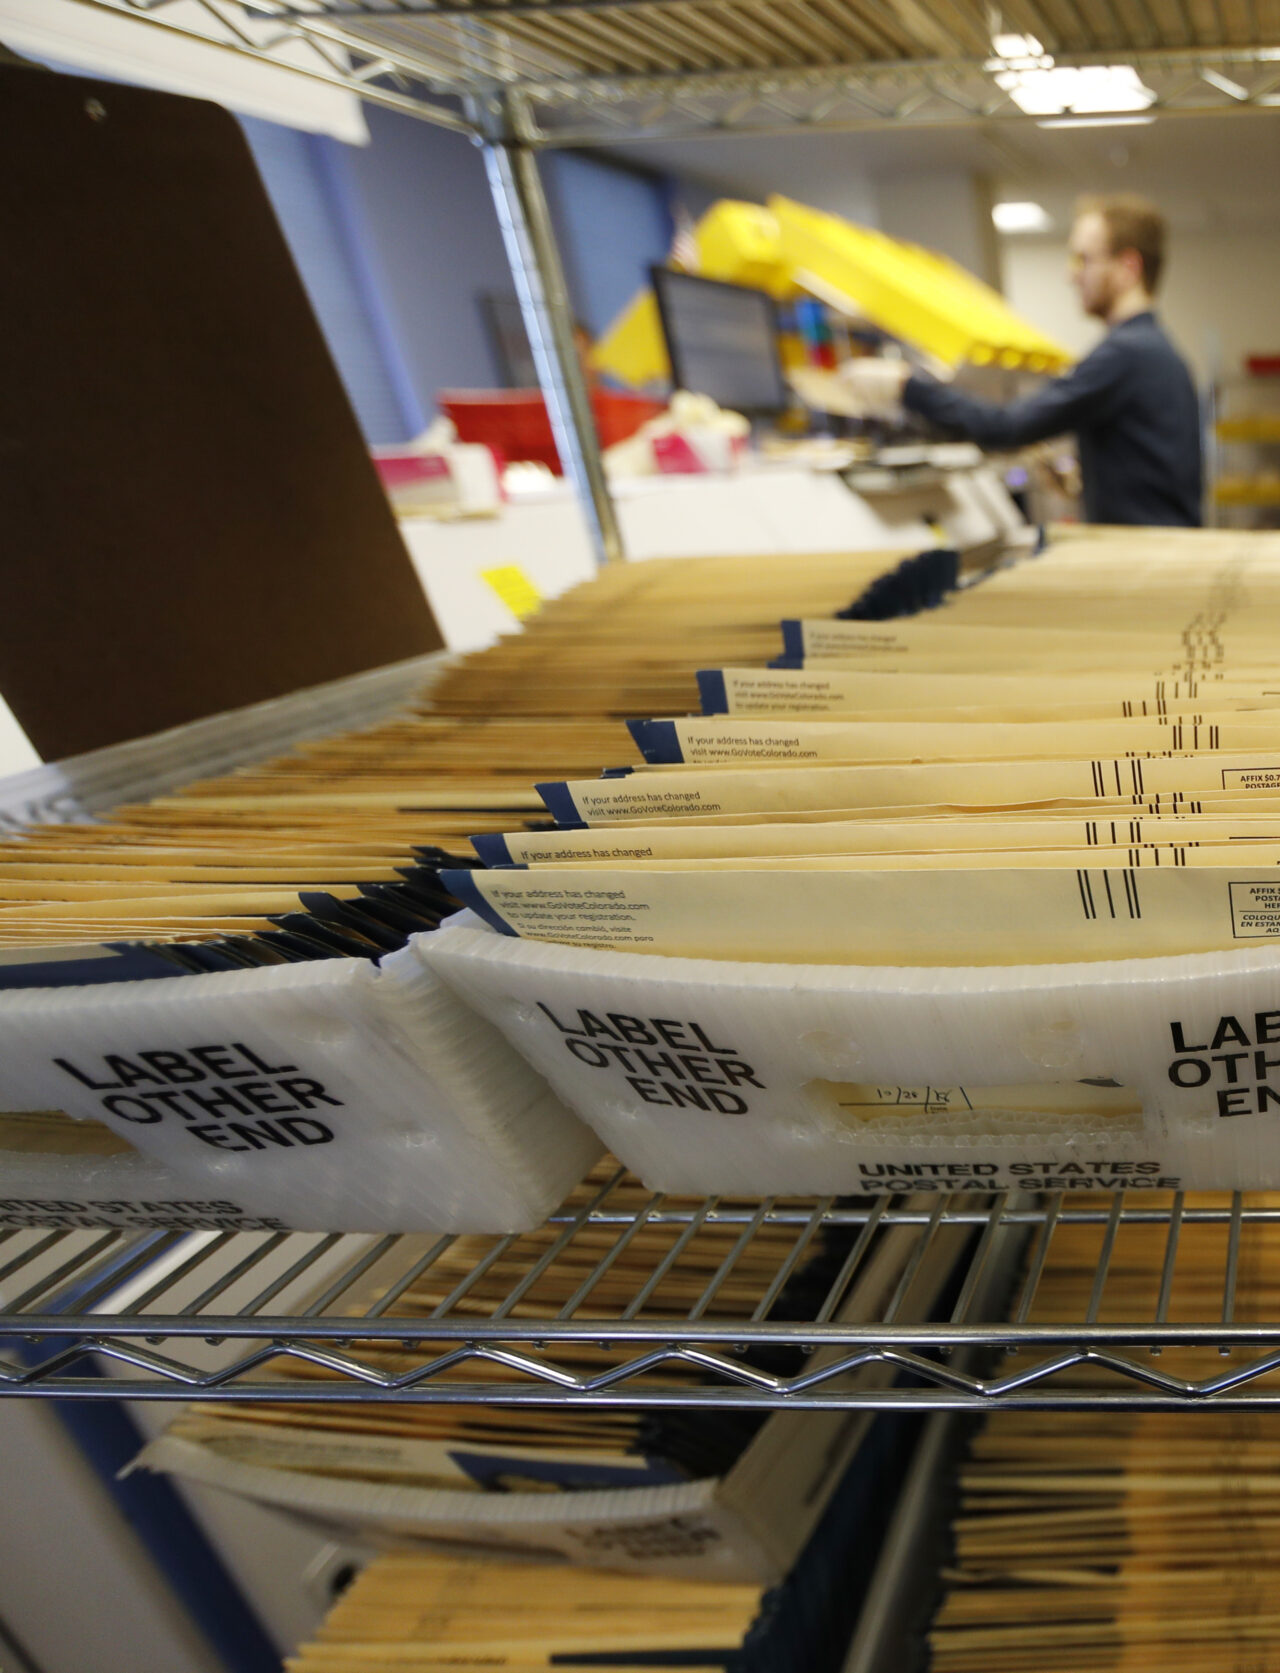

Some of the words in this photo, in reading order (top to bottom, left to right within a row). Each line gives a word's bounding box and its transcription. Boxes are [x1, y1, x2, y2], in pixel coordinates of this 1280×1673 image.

[687, 736, 694, 744] If
[695, 738, 714, 747] your
[716, 736, 748, 745] address
[749, 737, 763, 745] has
[764, 737, 800, 747] changed
[690, 747, 708, 756] visit
[709, 748, 818, 758] www.GoVoteColorado.com
[582, 796, 590, 805] If
[590, 796, 610, 806] your
[613, 794, 646, 804] address
[647, 793, 663, 801] has
[664, 791, 701, 802] changed
[587, 807, 605, 817] visit
[605, 802, 722, 815] www.GoVoteColorado.com
[521, 850, 529, 860] If
[530, 851, 552, 861] your
[554, 847, 592, 859] address
[593, 848, 610, 858] has
[612, 847, 653, 858] changed
[500, 891, 523, 900] your
[525, 890, 564, 899] address
[564, 890, 583, 899] has
[584, 890, 626, 901] changed
[522, 902, 650, 911] www.GoVoteColorado.com
[520, 912, 554, 921] update
[555, 913, 576, 922] your
[634, 935, 654, 943] para
[536, 1001, 740, 1055] LABEL
[53, 1042, 300, 1092] LABEL
[564, 1037, 766, 1090] OTHER
[100, 1077, 345, 1125] OTHER
[625, 1076, 749, 1116] END
[186, 1116, 337, 1152] END
[858, 1163, 999, 1177] UNITED
[1009, 1161, 1161, 1175] STATES
[860, 1179, 1010, 1191] POSTAL
[1018, 1177, 1182, 1190] SERVICE
[89, 1200, 244, 1215] STATES
[0, 1214, 132, 1228] OSTAL
[126, 1216, 292, 1230] SERVICE
